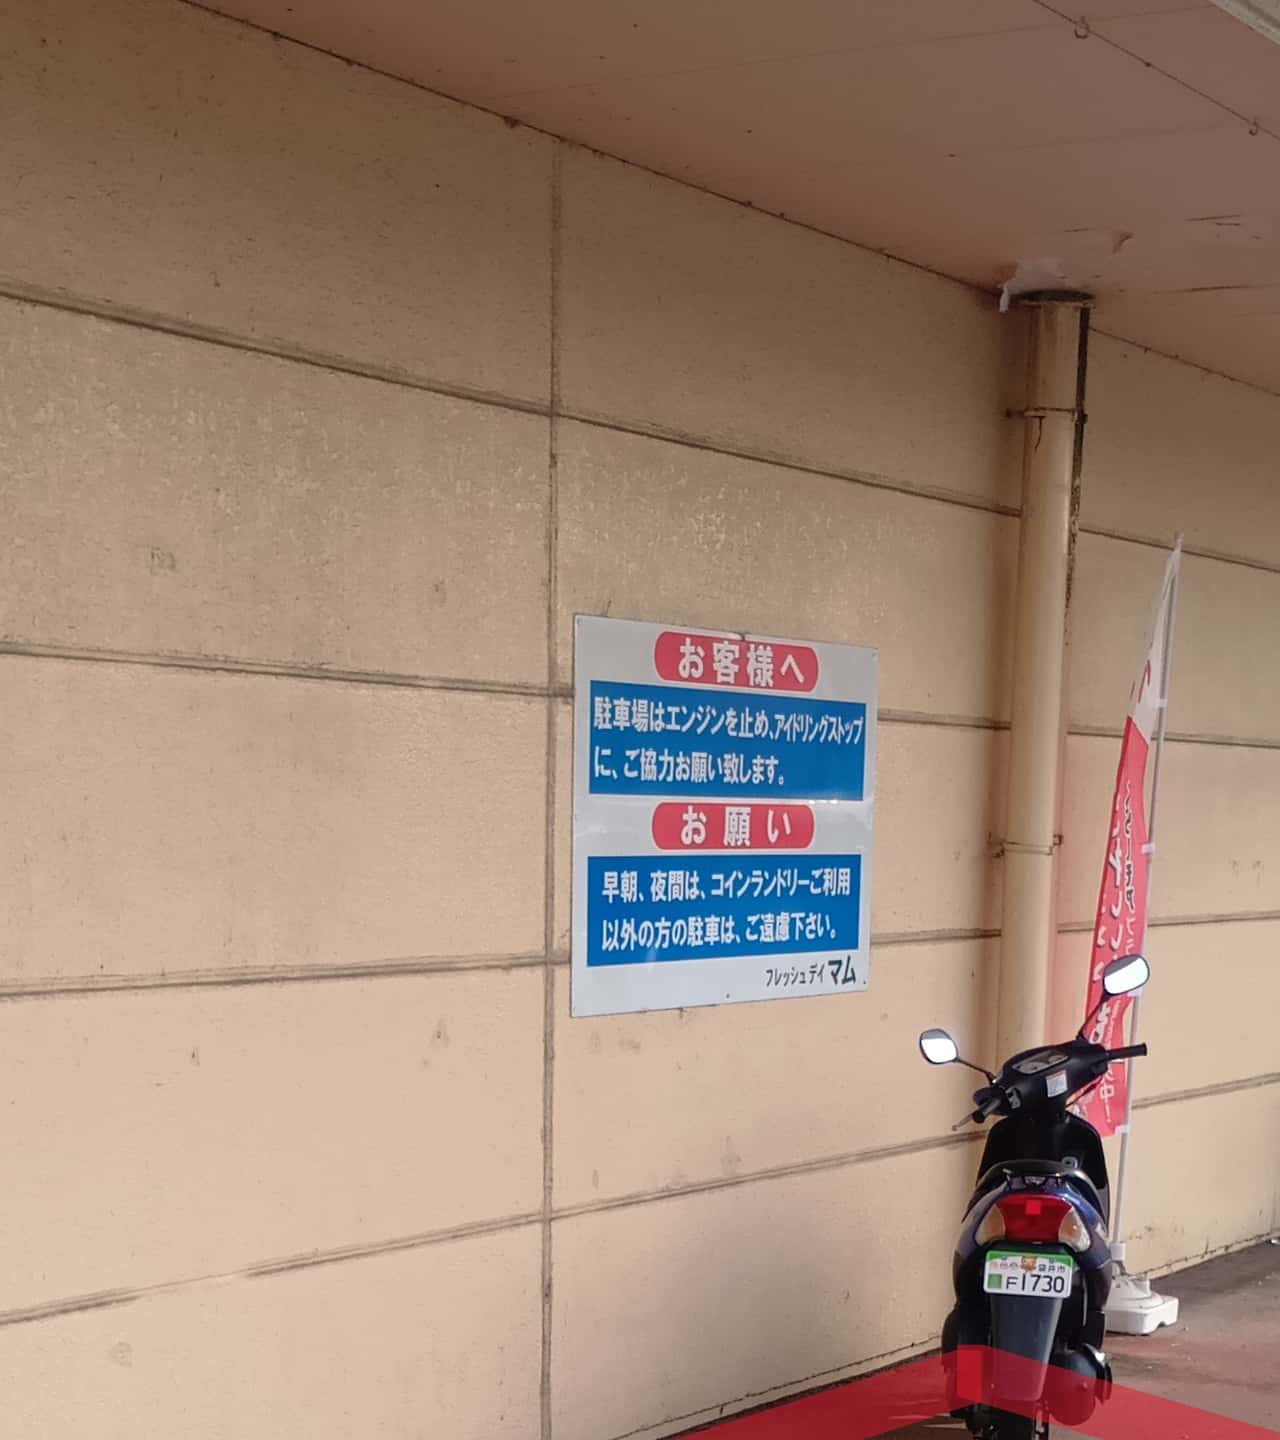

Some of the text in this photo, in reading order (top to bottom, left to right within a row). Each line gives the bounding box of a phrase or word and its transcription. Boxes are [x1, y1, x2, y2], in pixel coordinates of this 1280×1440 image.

[678, 637, 805, 687] お客様へ
[593, 696, 864, 745] 駐車場はエンジンを止め、アイドリングストップ
[594, 745, 785, 785] に、ご協力お願い致します。
[681, 805, 791, 847] お願い
[601, 867, 851, 904] 早朝、夜間は、コインランドリーご利用
[601, 912, 836, 952] 以外の方の駐車は、ご遠慮下さい。
